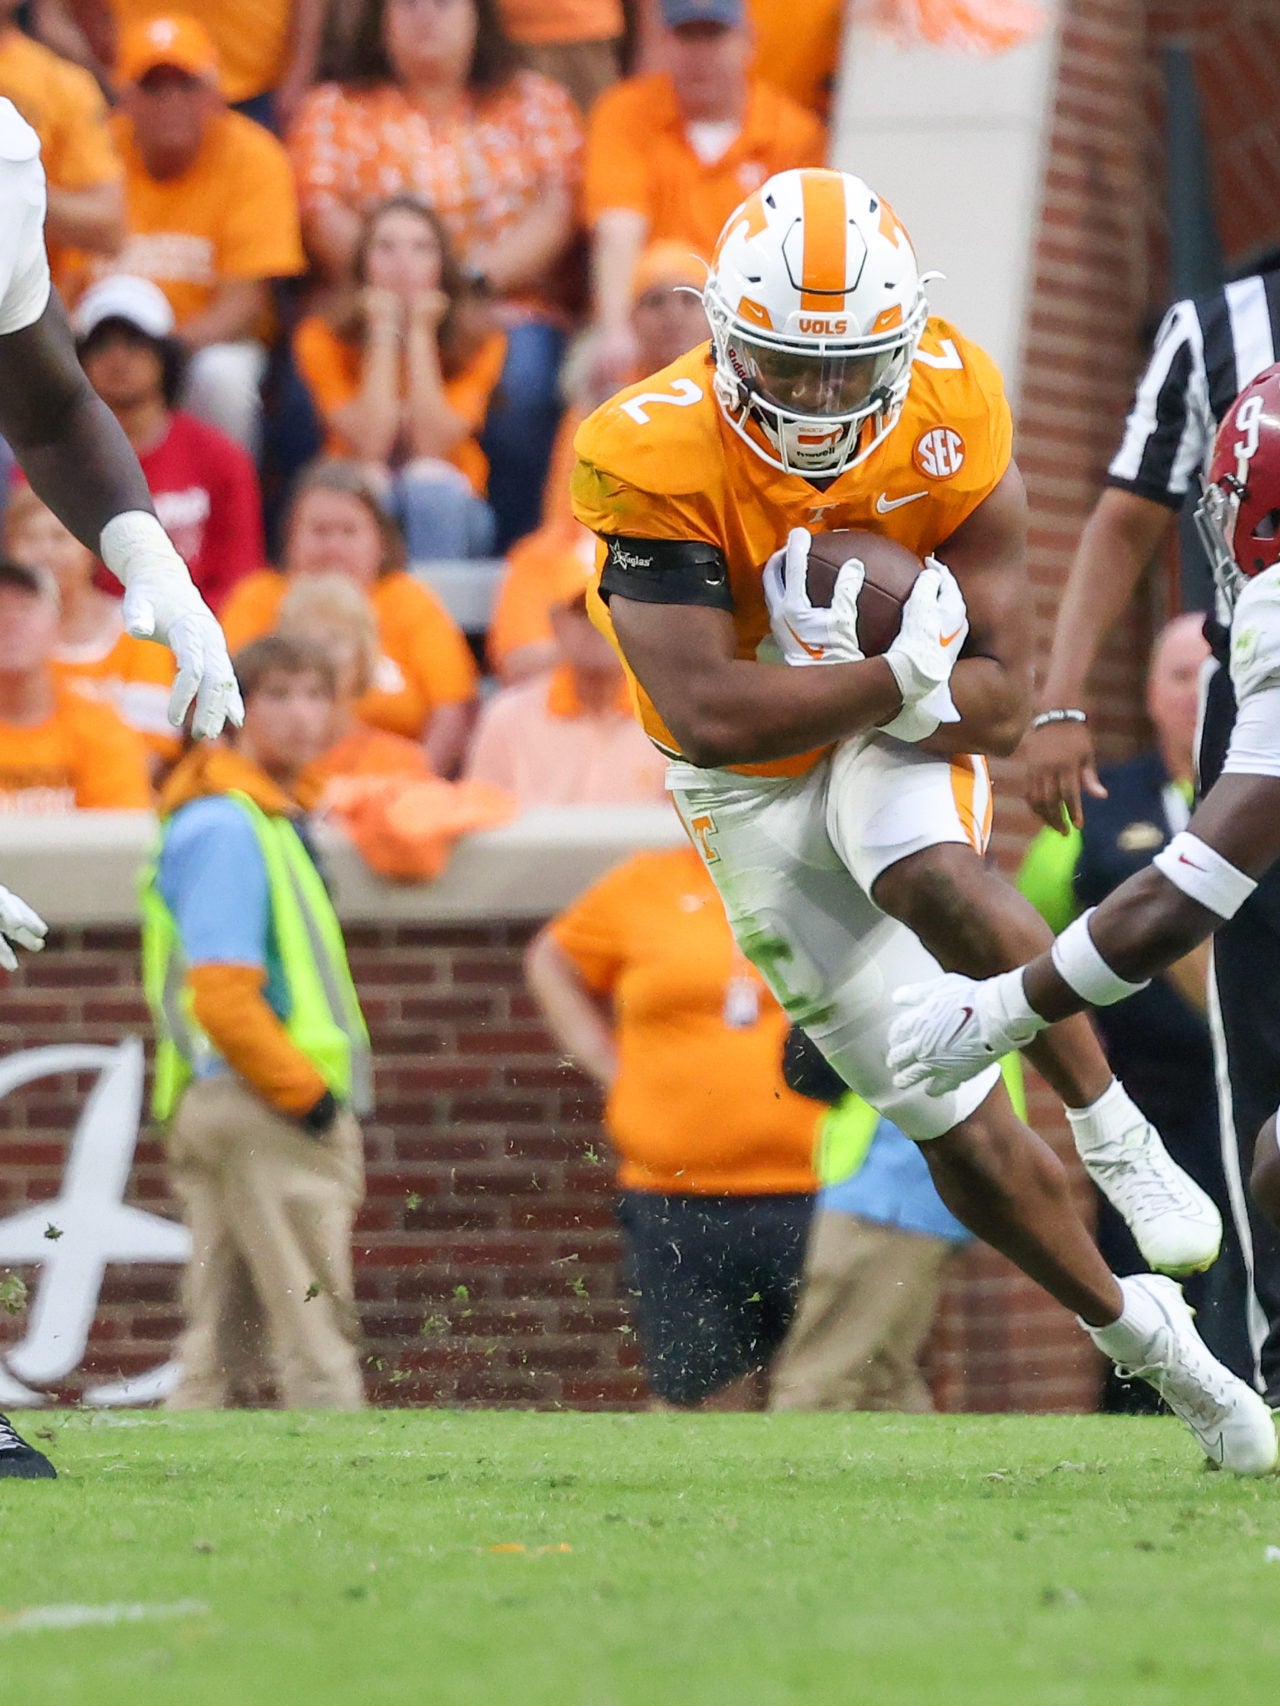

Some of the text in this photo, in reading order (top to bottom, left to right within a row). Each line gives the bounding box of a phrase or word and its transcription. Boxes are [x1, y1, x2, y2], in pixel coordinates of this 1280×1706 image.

[799, 319, 847, 335] VOLS
[619, 378, 704, 425] 2
[1233, 395, 1264, 459] 9
[917, 428, 965, 478] SEC
